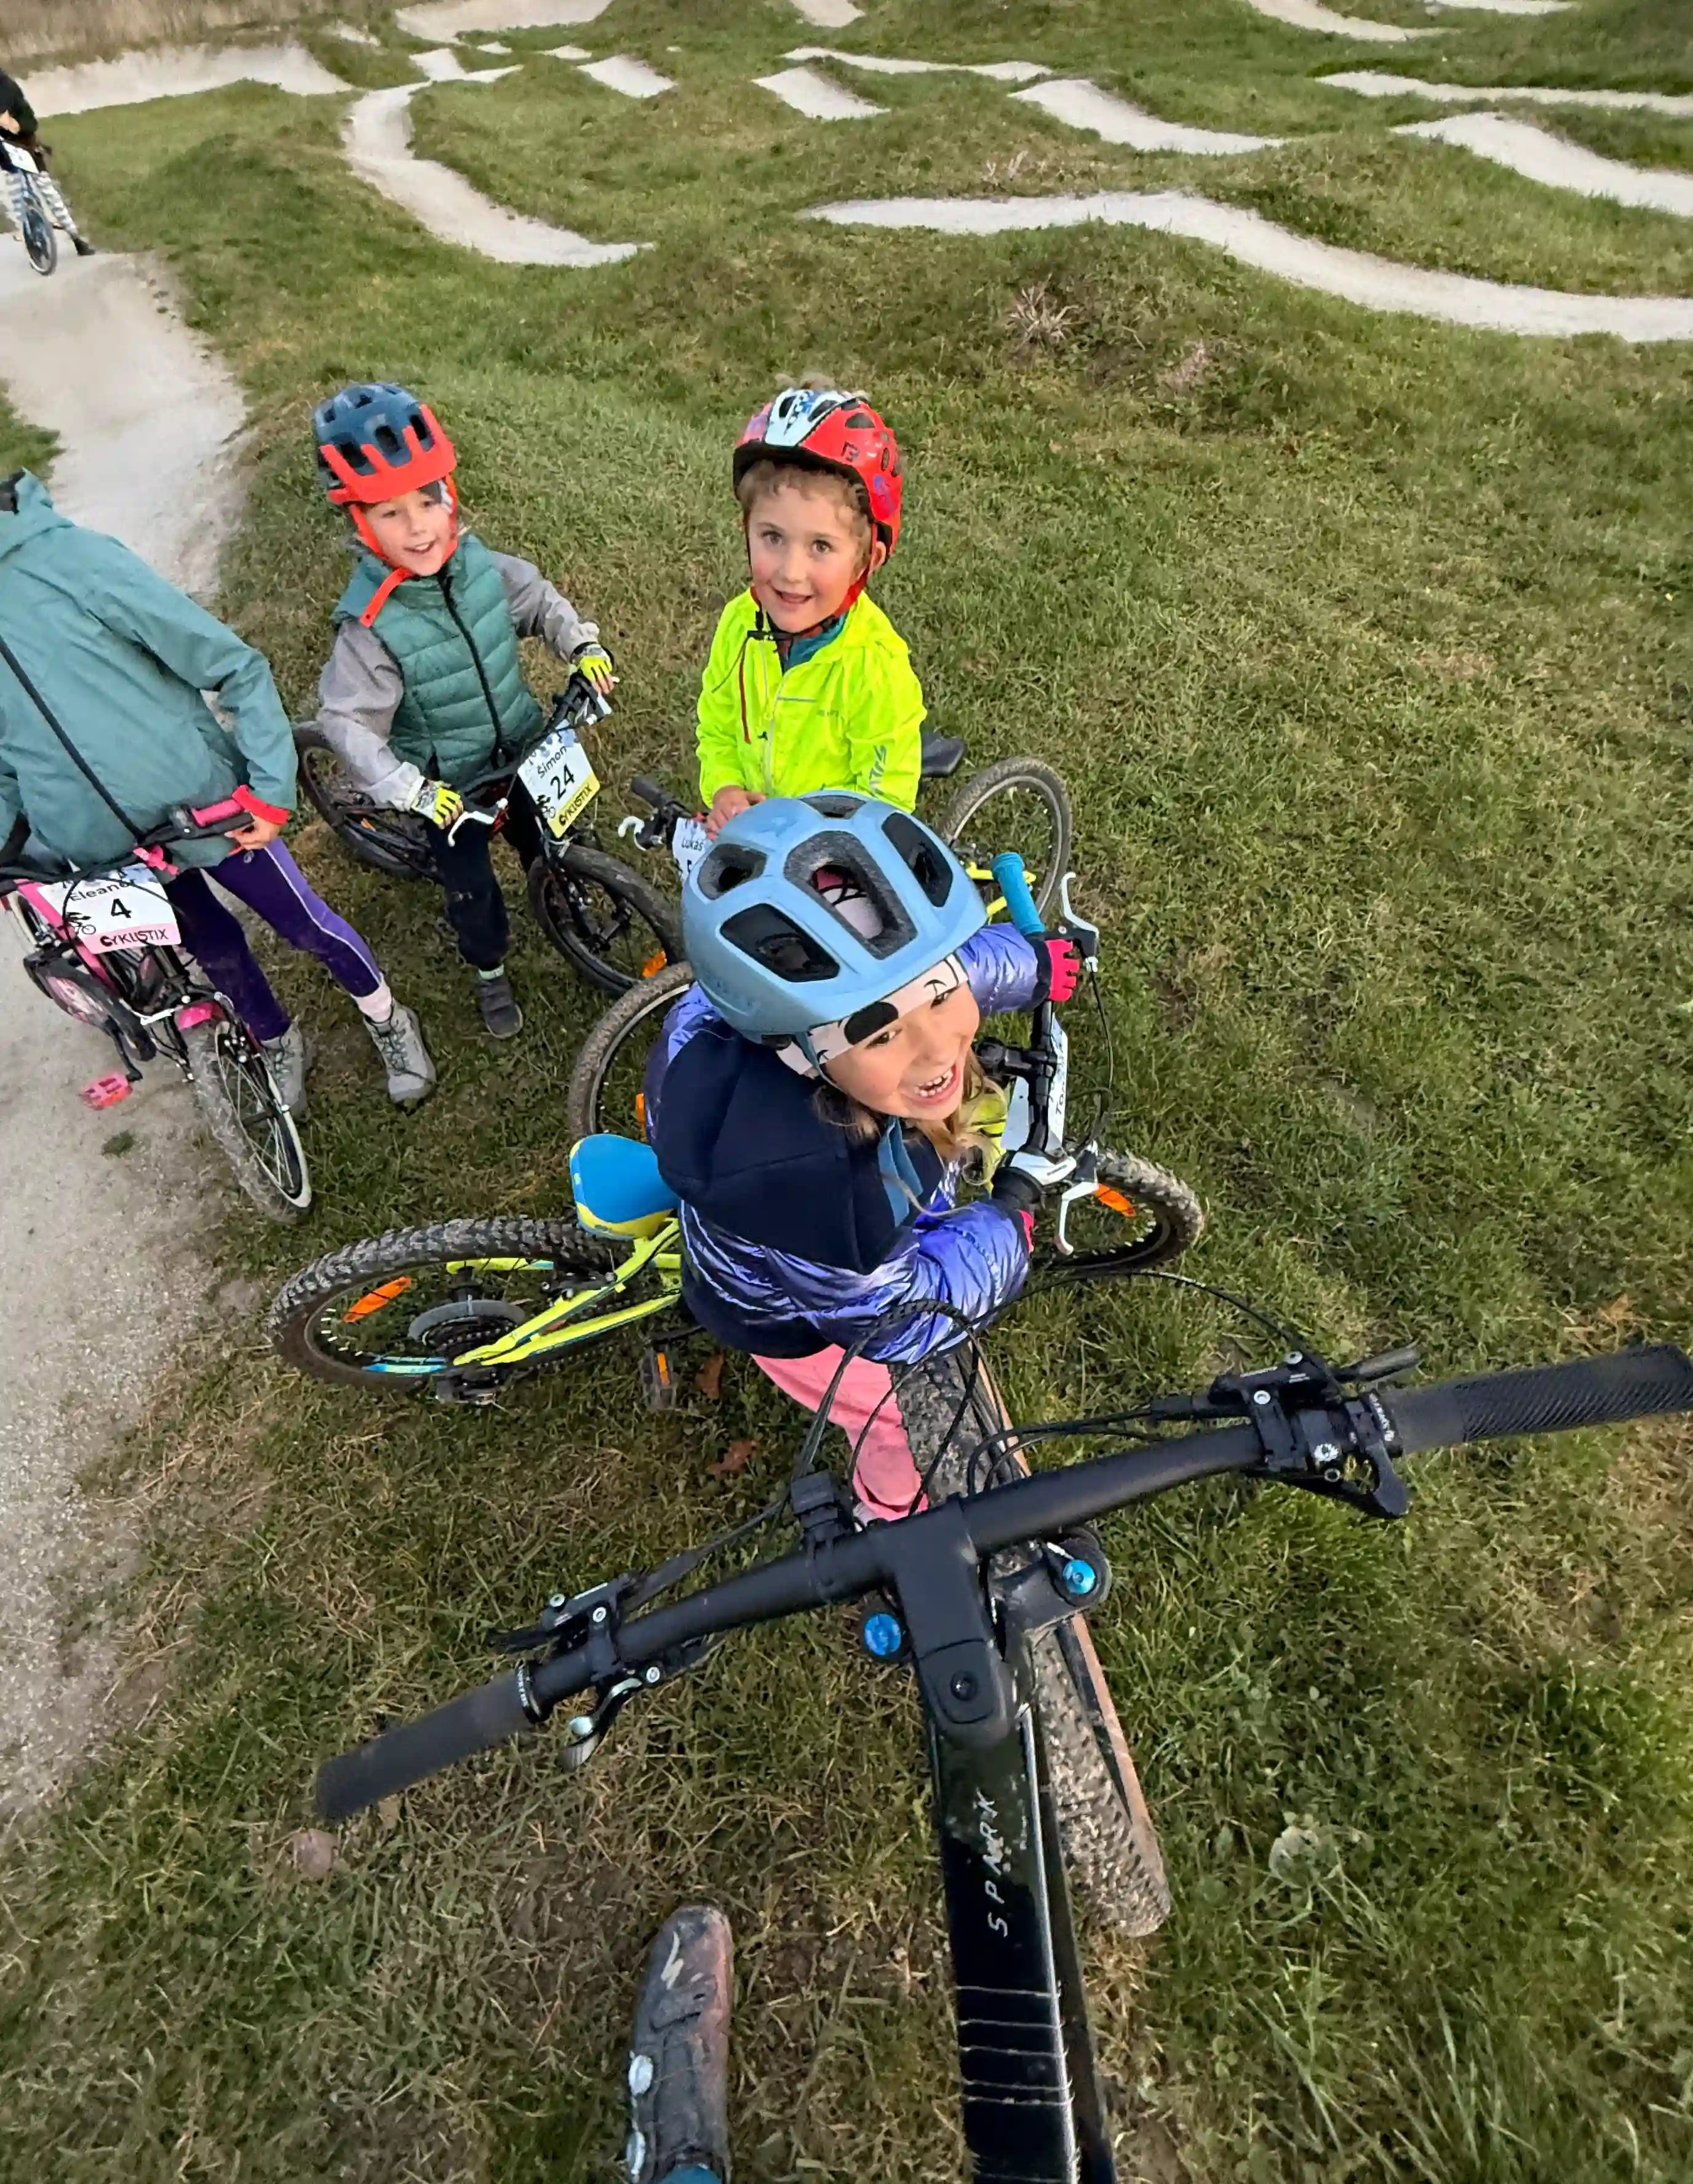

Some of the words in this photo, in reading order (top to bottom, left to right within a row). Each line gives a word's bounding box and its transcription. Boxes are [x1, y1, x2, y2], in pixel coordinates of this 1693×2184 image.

[550, 763, 575, 801] 24
[69, 881, 132, 902] Eleano
[111, 898, 132, 919] 4
[100, 928, 169, 947] CYKLISTIX
